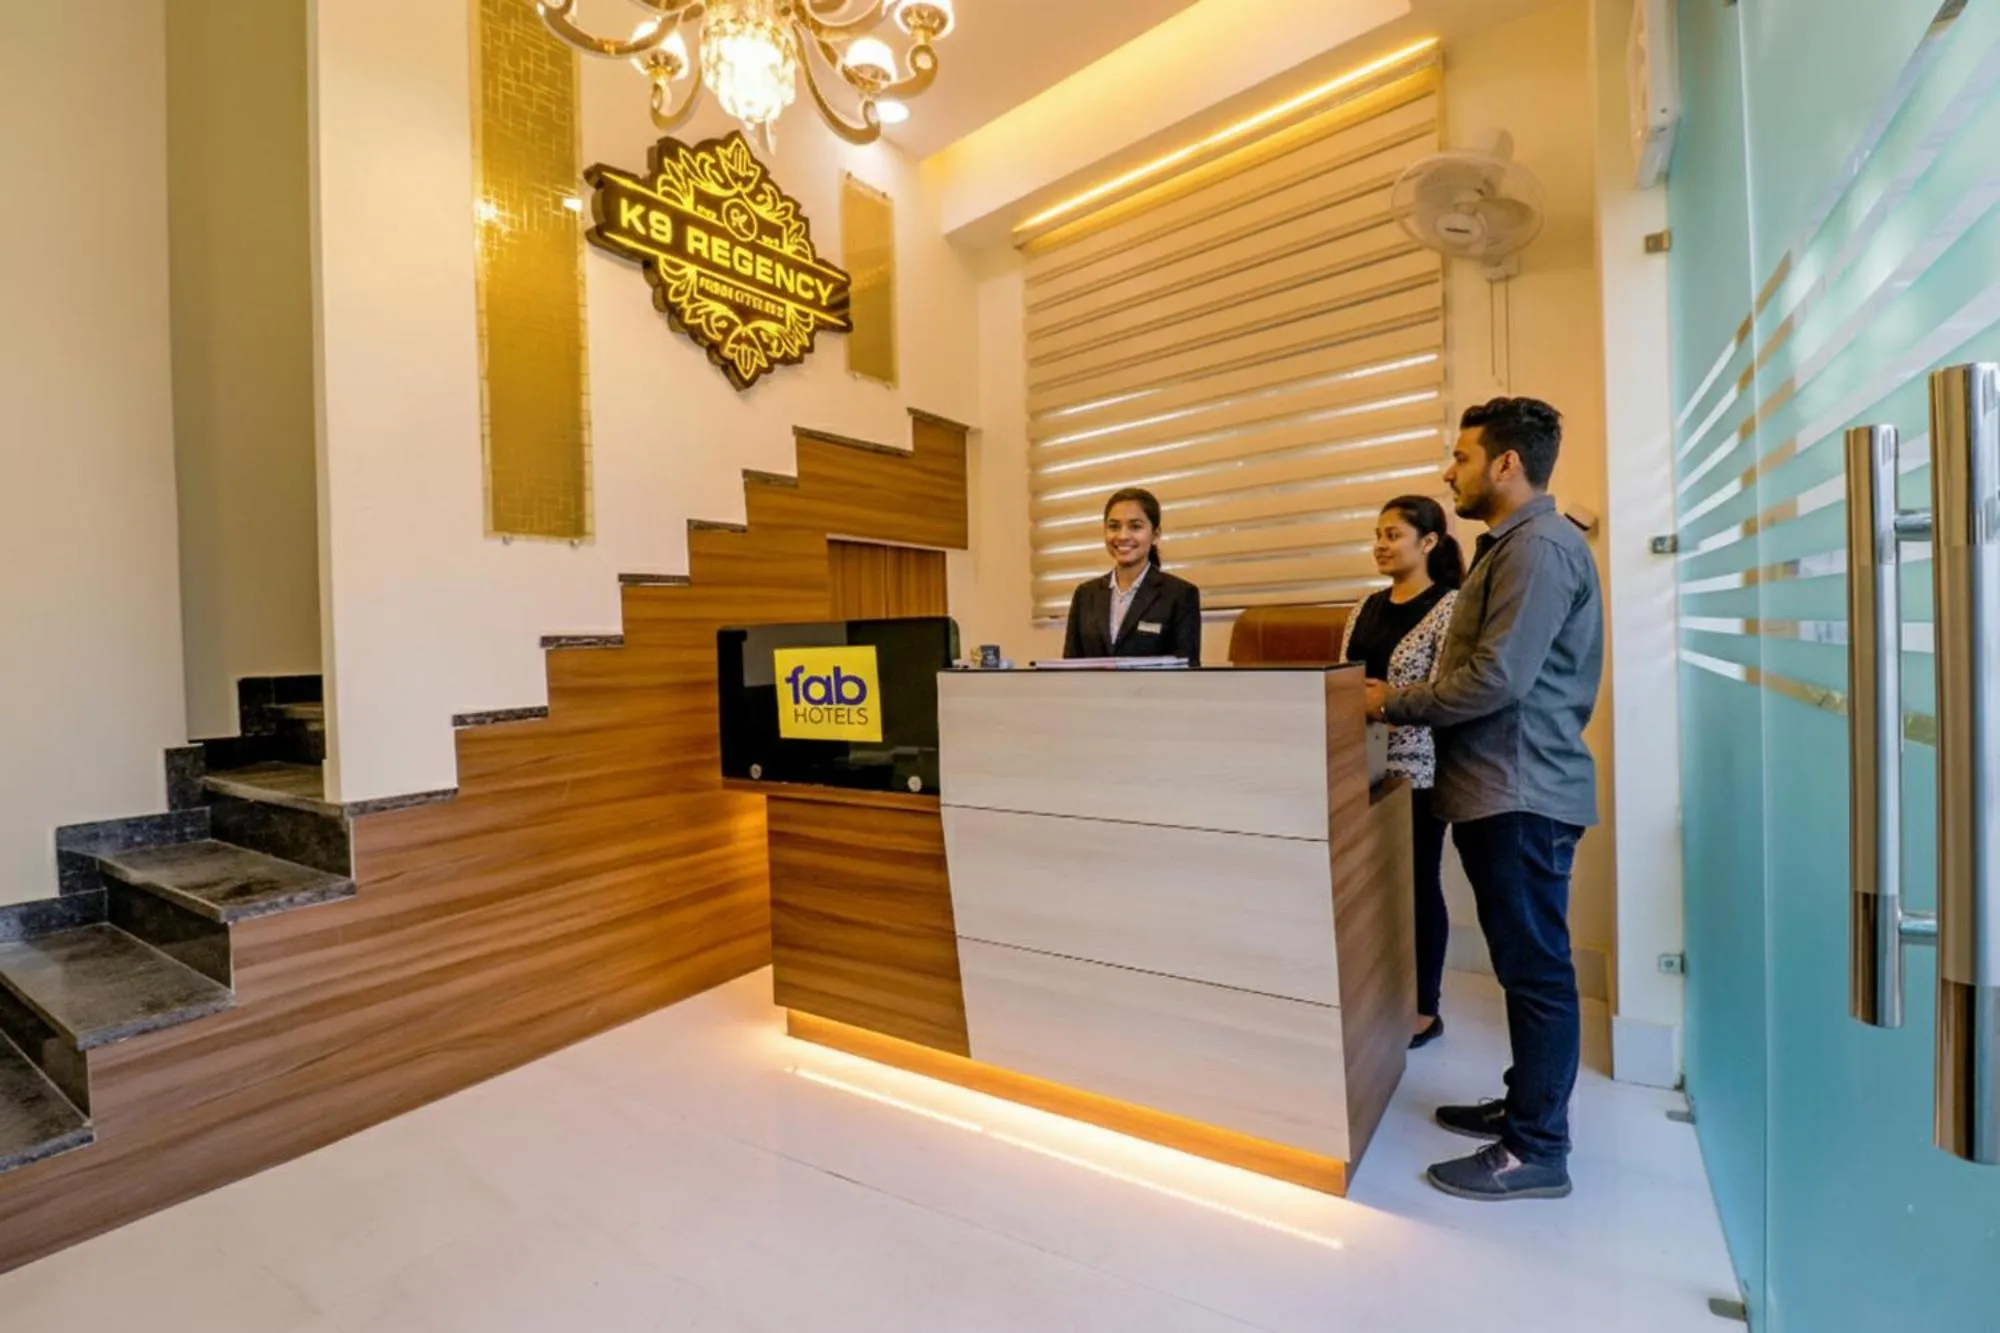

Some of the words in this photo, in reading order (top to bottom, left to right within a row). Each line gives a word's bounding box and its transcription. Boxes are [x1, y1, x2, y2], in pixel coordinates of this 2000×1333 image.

[620, 197, 673, 244] K9
[686, 225, 834, 306] REGENCY
[785, 665, 867, 705] fab
[794, 707, 869, 725] HOTELS
